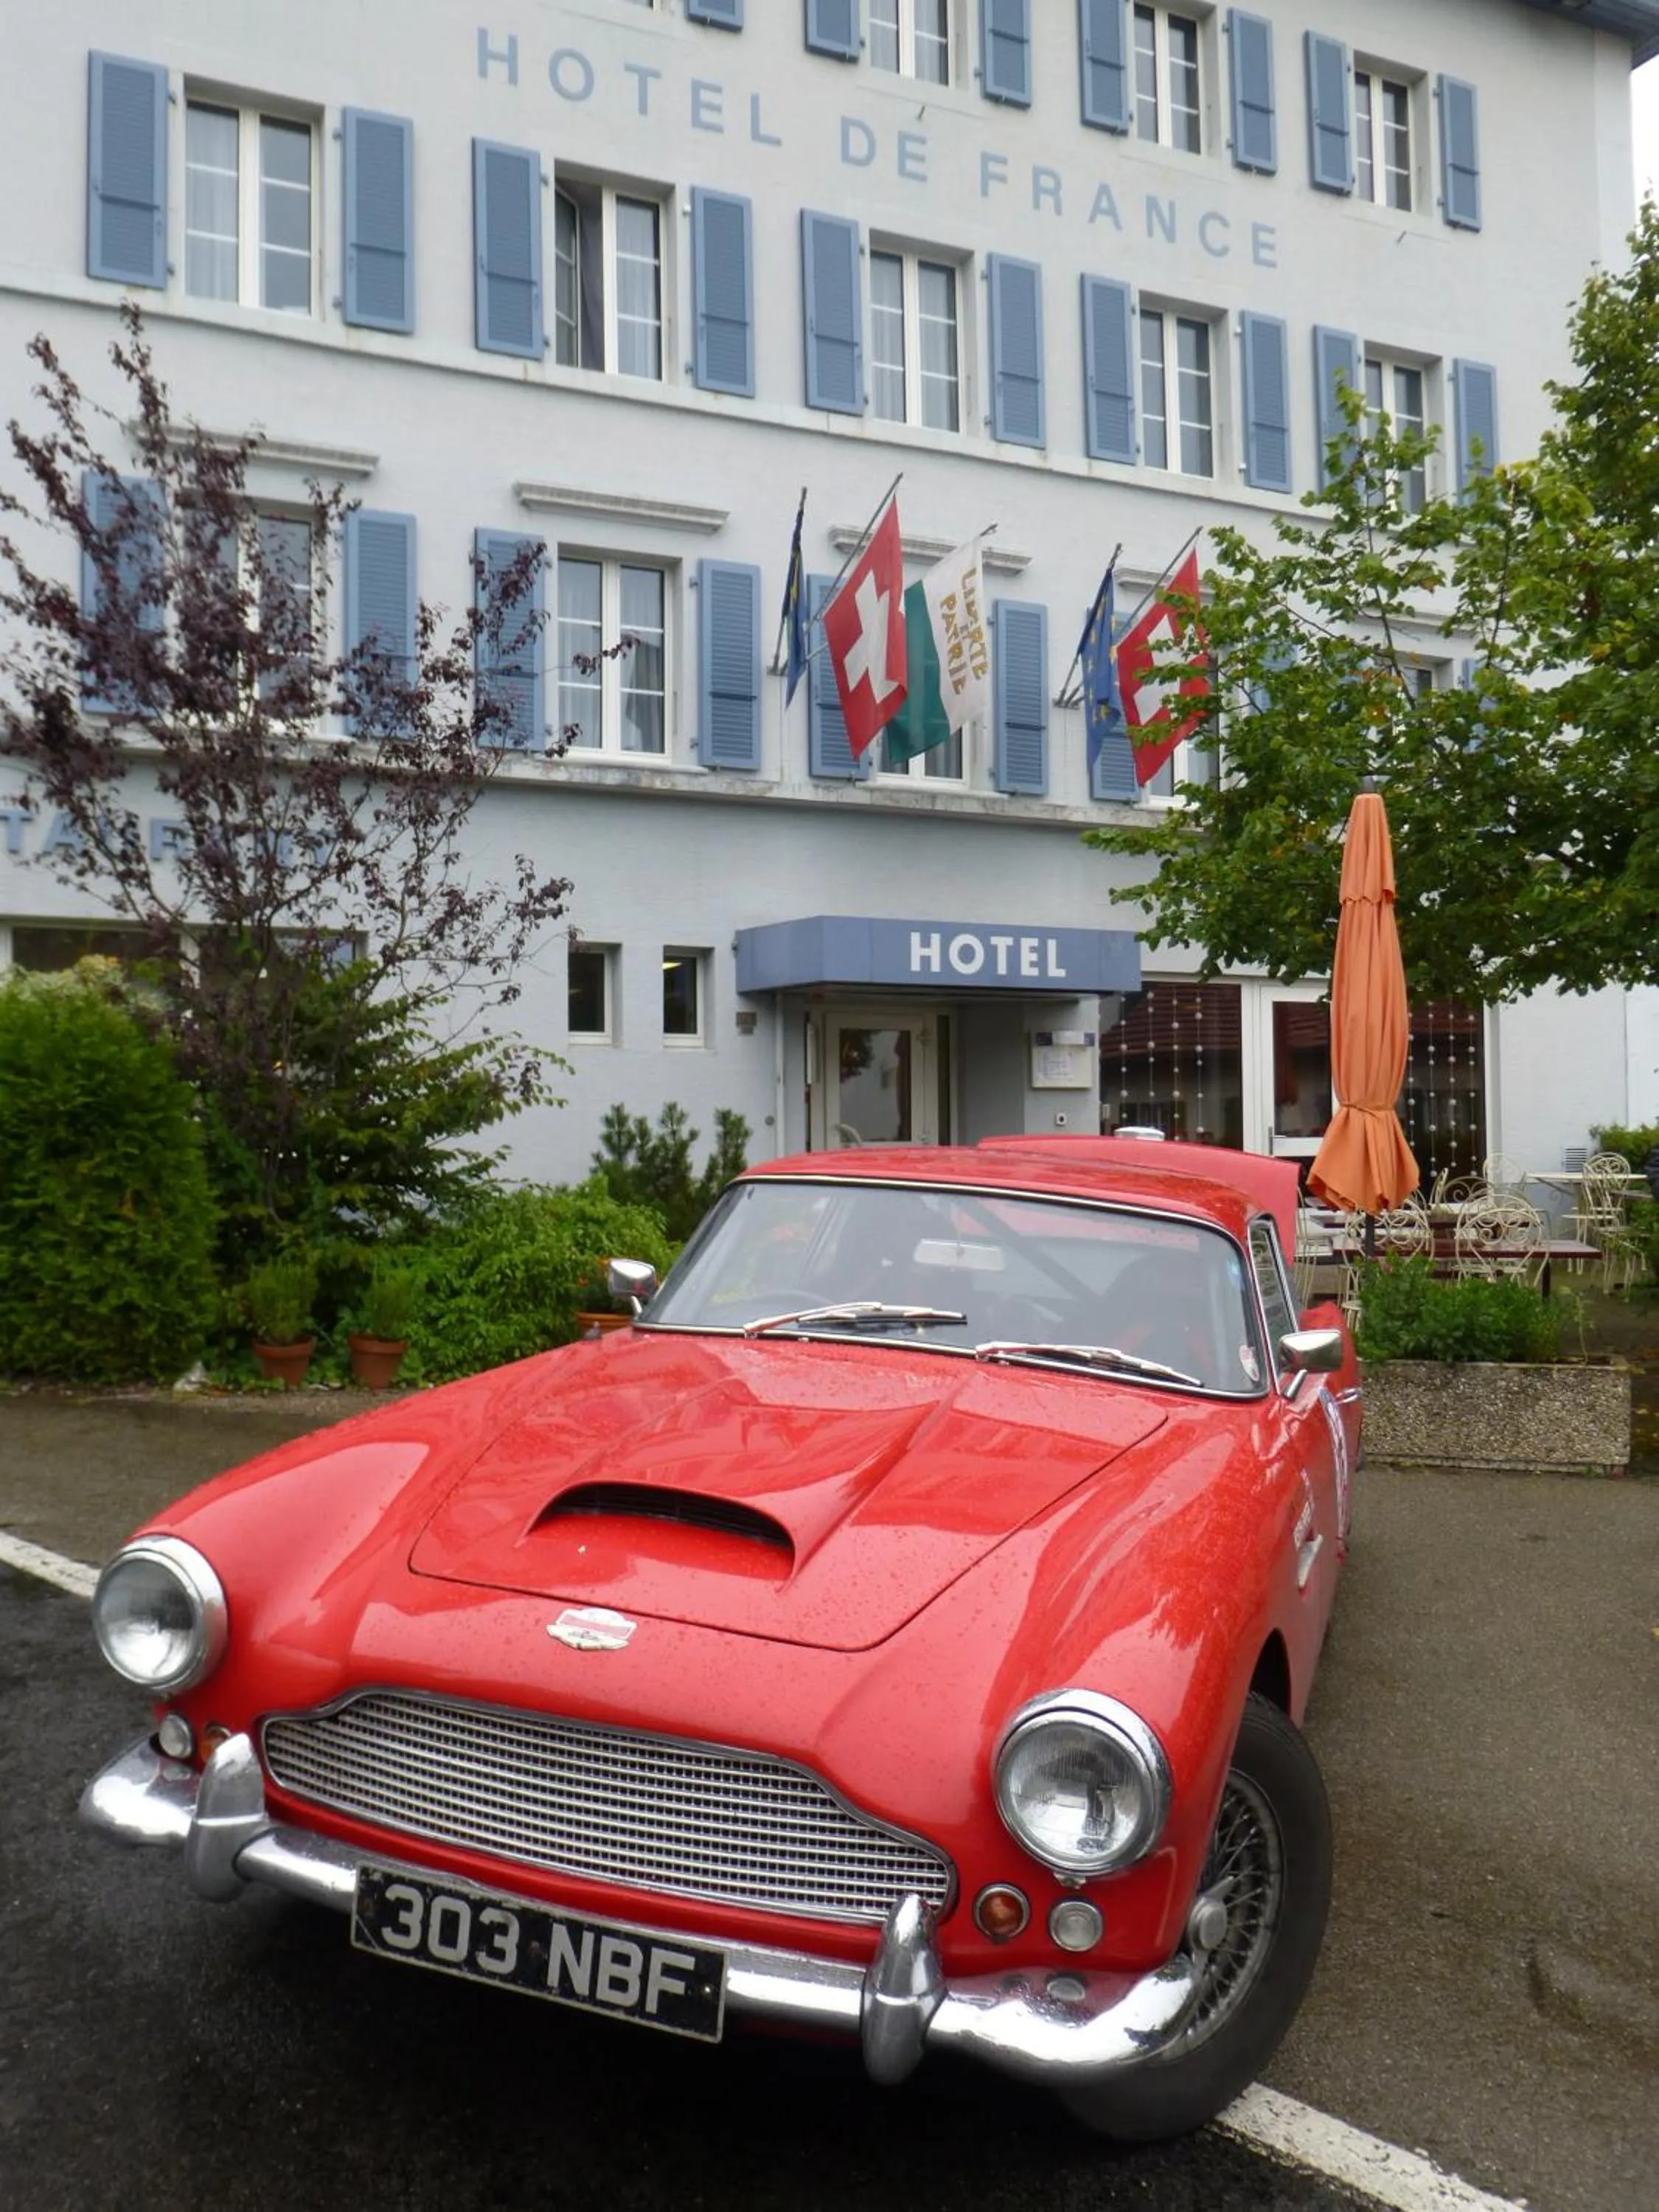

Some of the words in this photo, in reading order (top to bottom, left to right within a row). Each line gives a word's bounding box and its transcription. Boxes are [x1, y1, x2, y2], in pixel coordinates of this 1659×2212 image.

[477, 27, 782, 147] HOTEL
[840, 115, 928, 183] DE
[980, 150, 1278, 268] FRANCE
[940, 592, 967, 695] PATRIE
[910, 931, 1067, 978] HOTEL
[380, 1882, 520, 1975] 303
[546, 1922, 695, 2015] NBF
